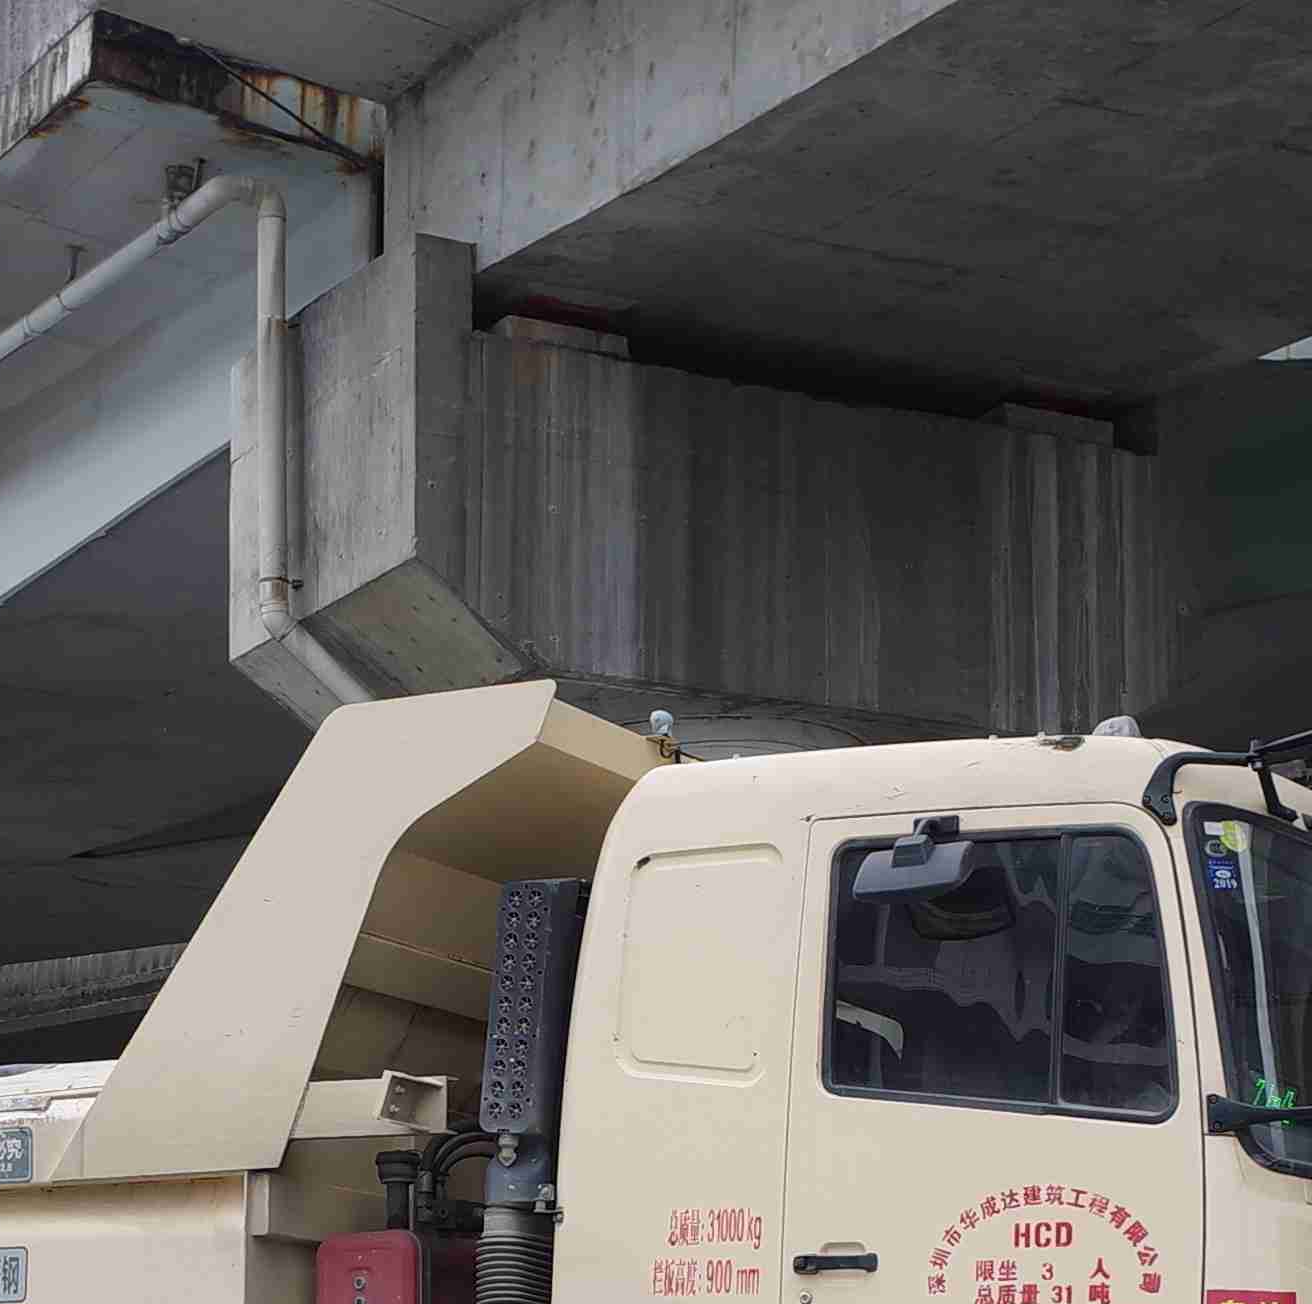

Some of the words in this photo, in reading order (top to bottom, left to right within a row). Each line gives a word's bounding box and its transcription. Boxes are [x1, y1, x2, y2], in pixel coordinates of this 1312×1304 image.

[707, 1208, 744, 1243] 31000
[927, 1184, 1161, 1294] 深圳市华成达建筑工程有限公司
[1013, 1221, 1073, 1248] HCD
[706, 1259, 732, 1294] 900
[735, 1268, 760, 1296] mm
[975, 1259, 1017, 1282] 限坐
[1041, 1263, 1054, 1281] 3
[1090, 1257, 1111, 1279] 人
[1051, 1286, 1072, 1304] 31
